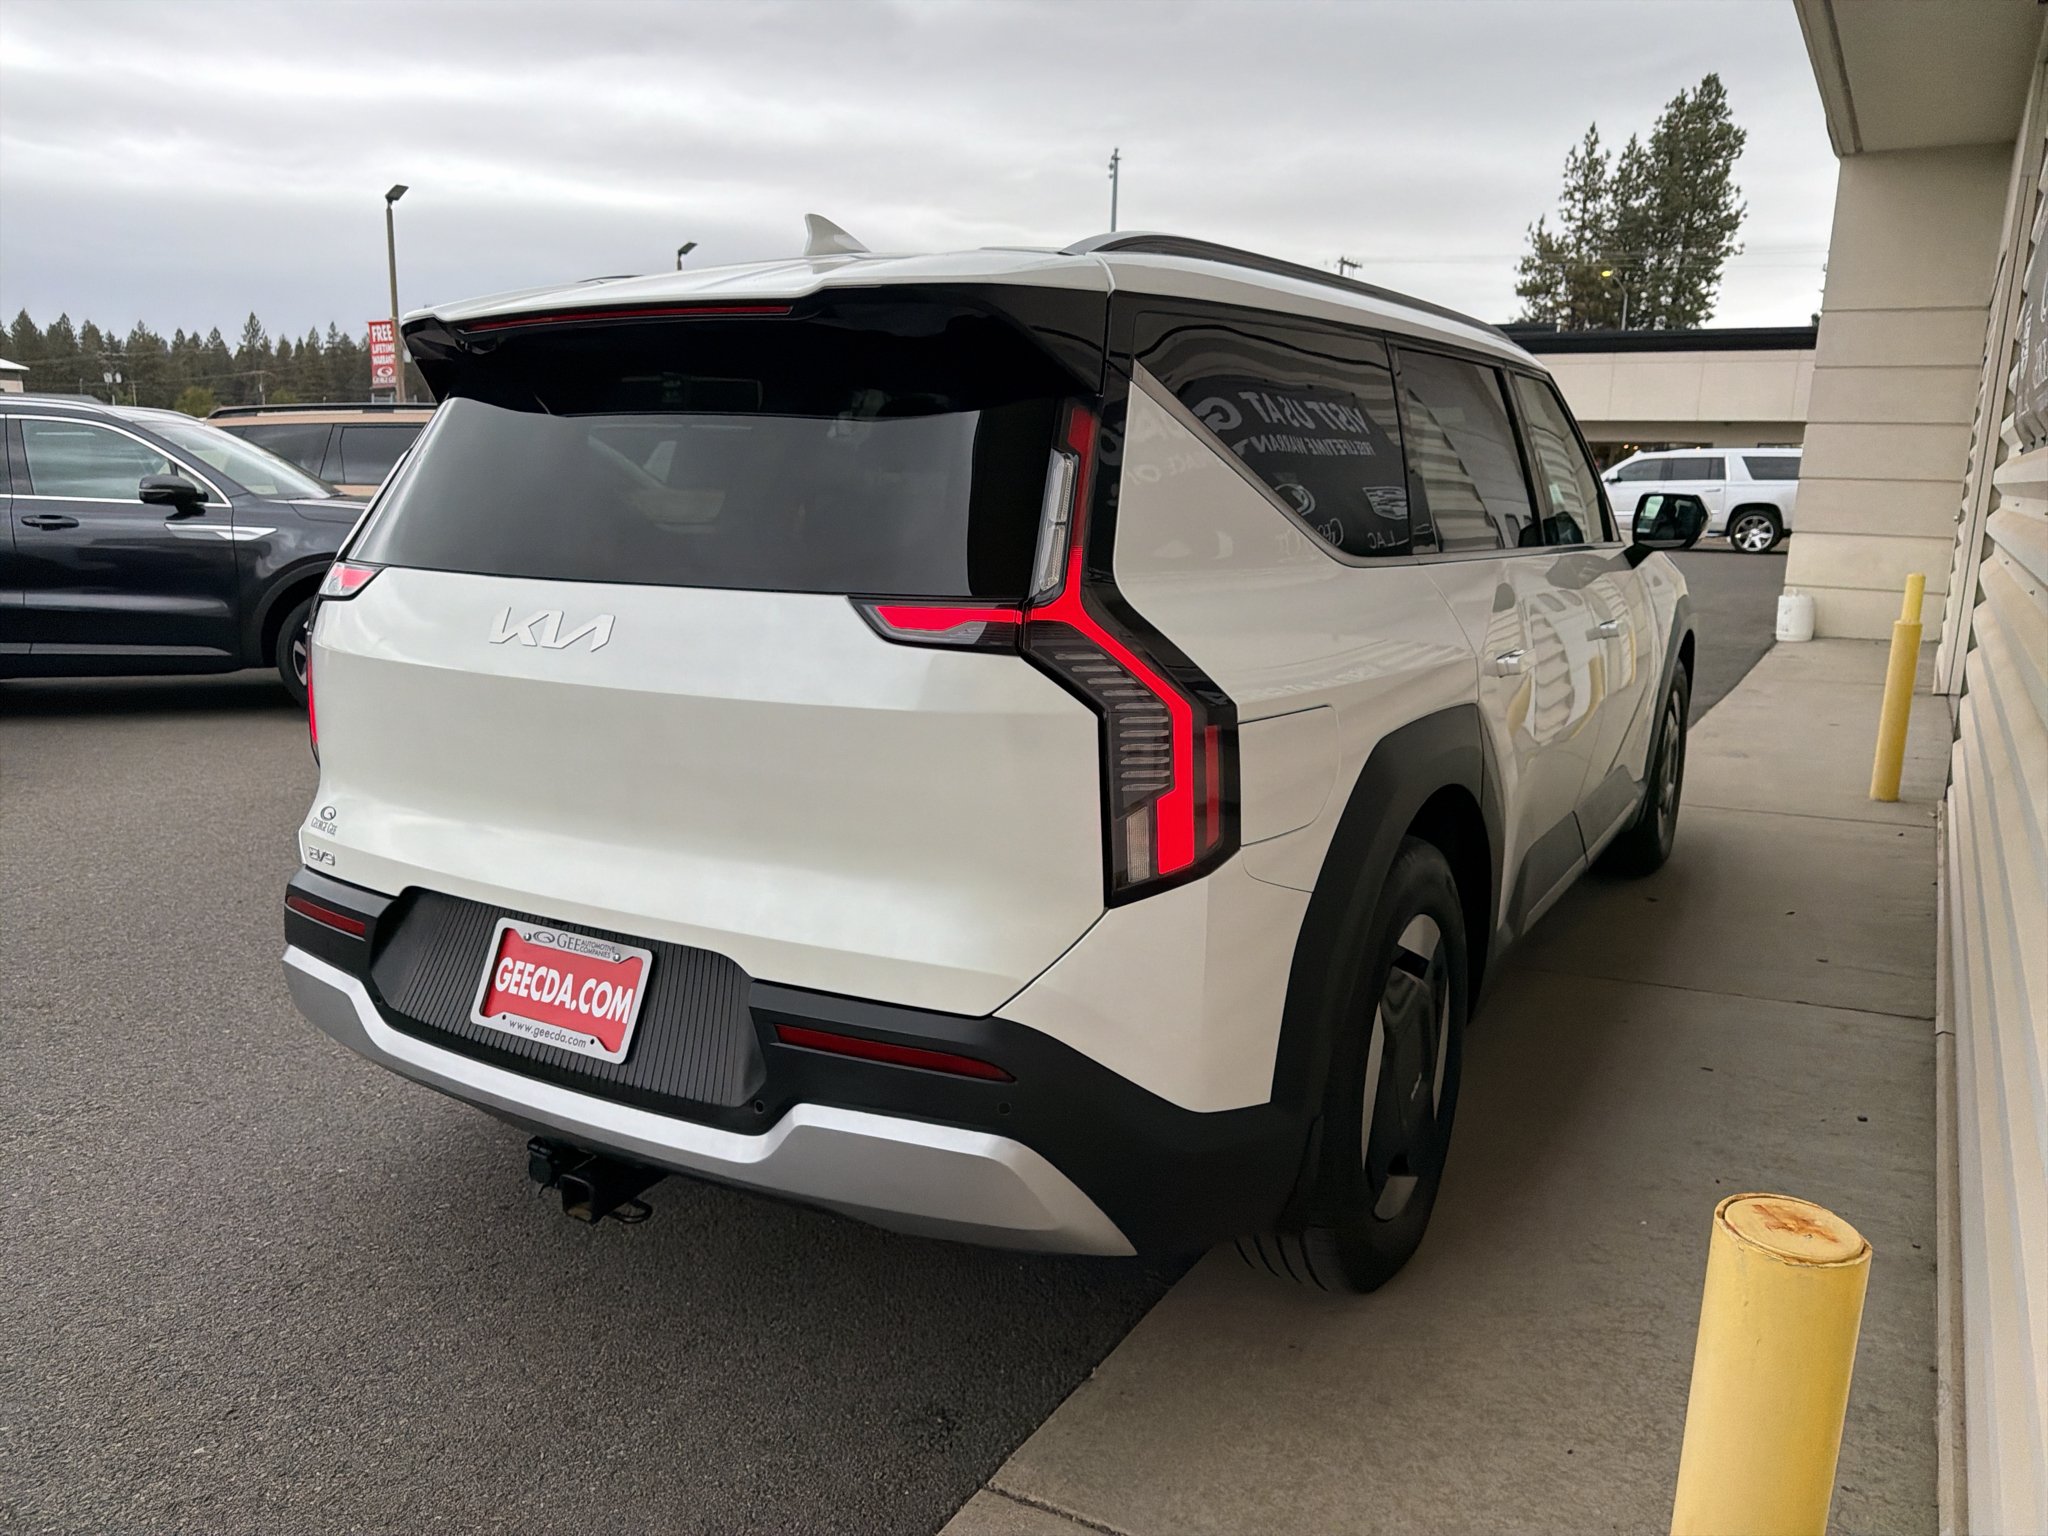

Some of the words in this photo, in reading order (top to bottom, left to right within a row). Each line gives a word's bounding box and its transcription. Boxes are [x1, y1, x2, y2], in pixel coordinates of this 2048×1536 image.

[371, 324, 393, 342] FREE
[372, 343, 395, 353] LIFETIM
[489, 605, 616, 653] KIA
[557, 933, 581, 951] GEE
[581, 940, 616, 953] AUTOMOTIVE
[580, 946, 611, 959] COMPANIES
[495, 957, 634, 1024] GEECDA.COM
[509, 1020, 587, 1048] www.geecda.com
